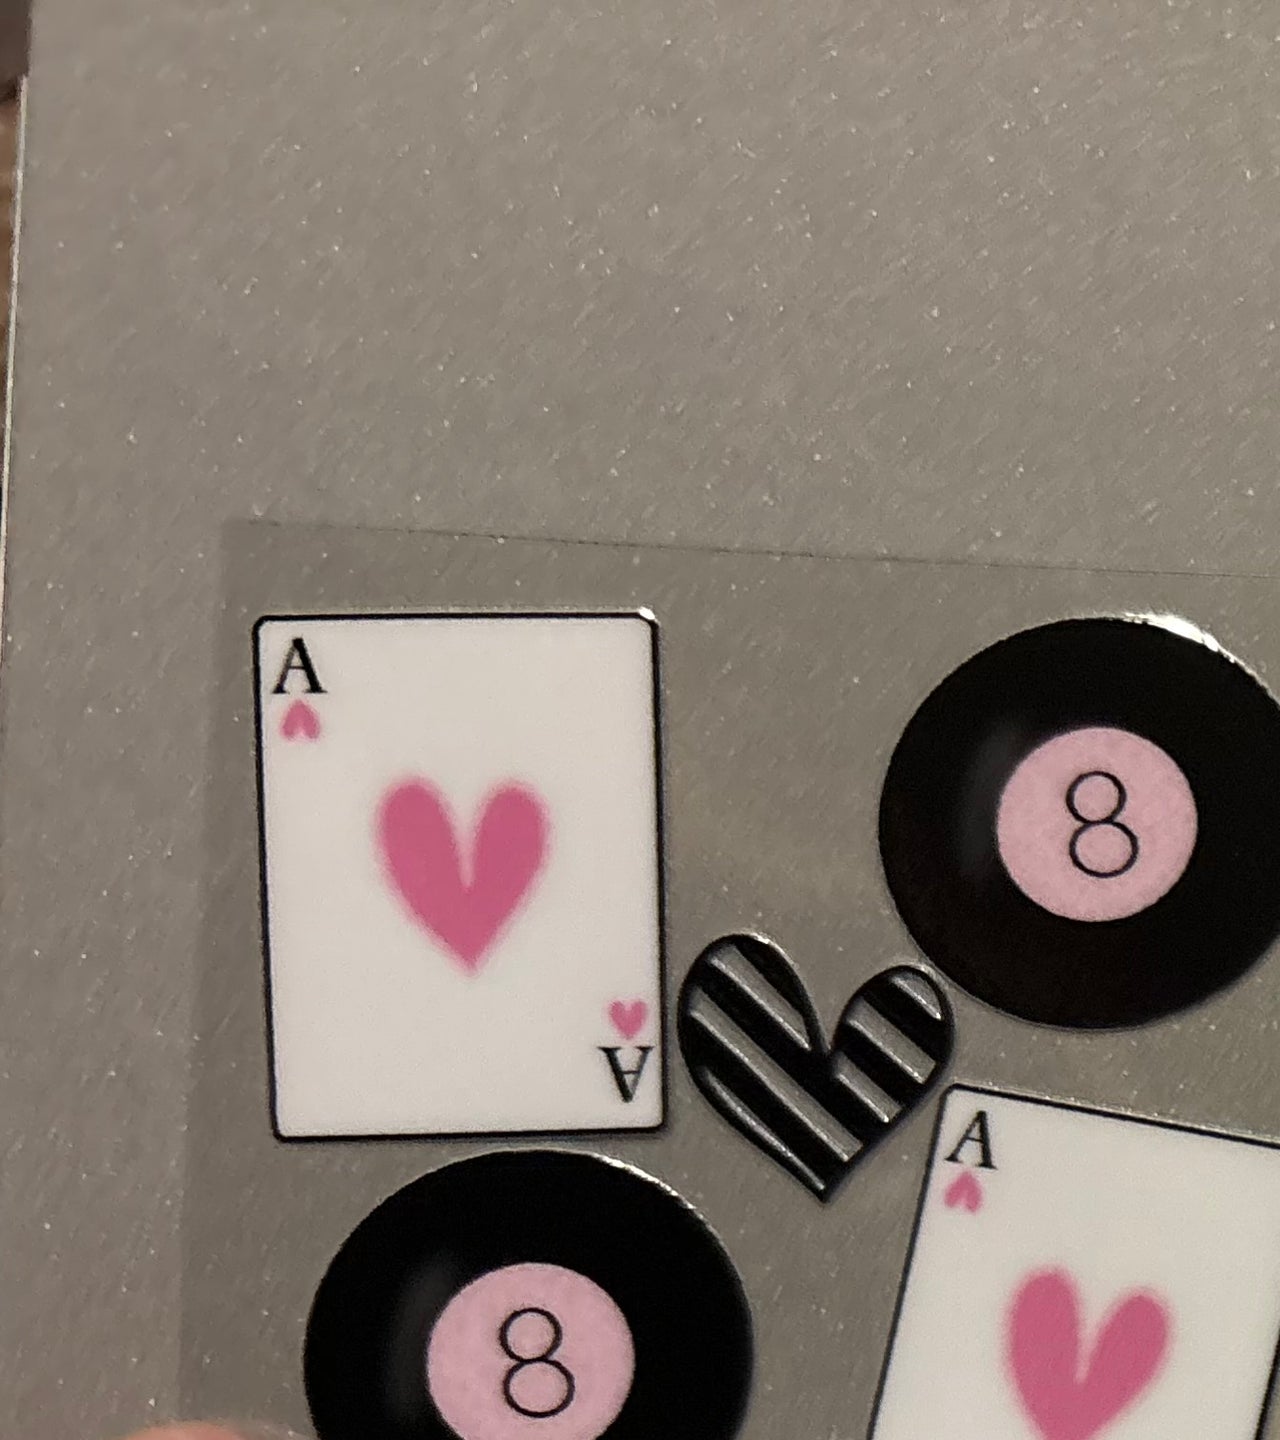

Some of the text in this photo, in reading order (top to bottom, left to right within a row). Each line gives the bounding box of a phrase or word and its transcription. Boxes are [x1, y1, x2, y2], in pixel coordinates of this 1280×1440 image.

[273, 638, 326, 694] A
[1065, 770, 1139, 879] 8
[599, 1046, 653, 1102] A
[945, 1111, 995, 1169] A
[497, 1307, 575, 1419] 8
